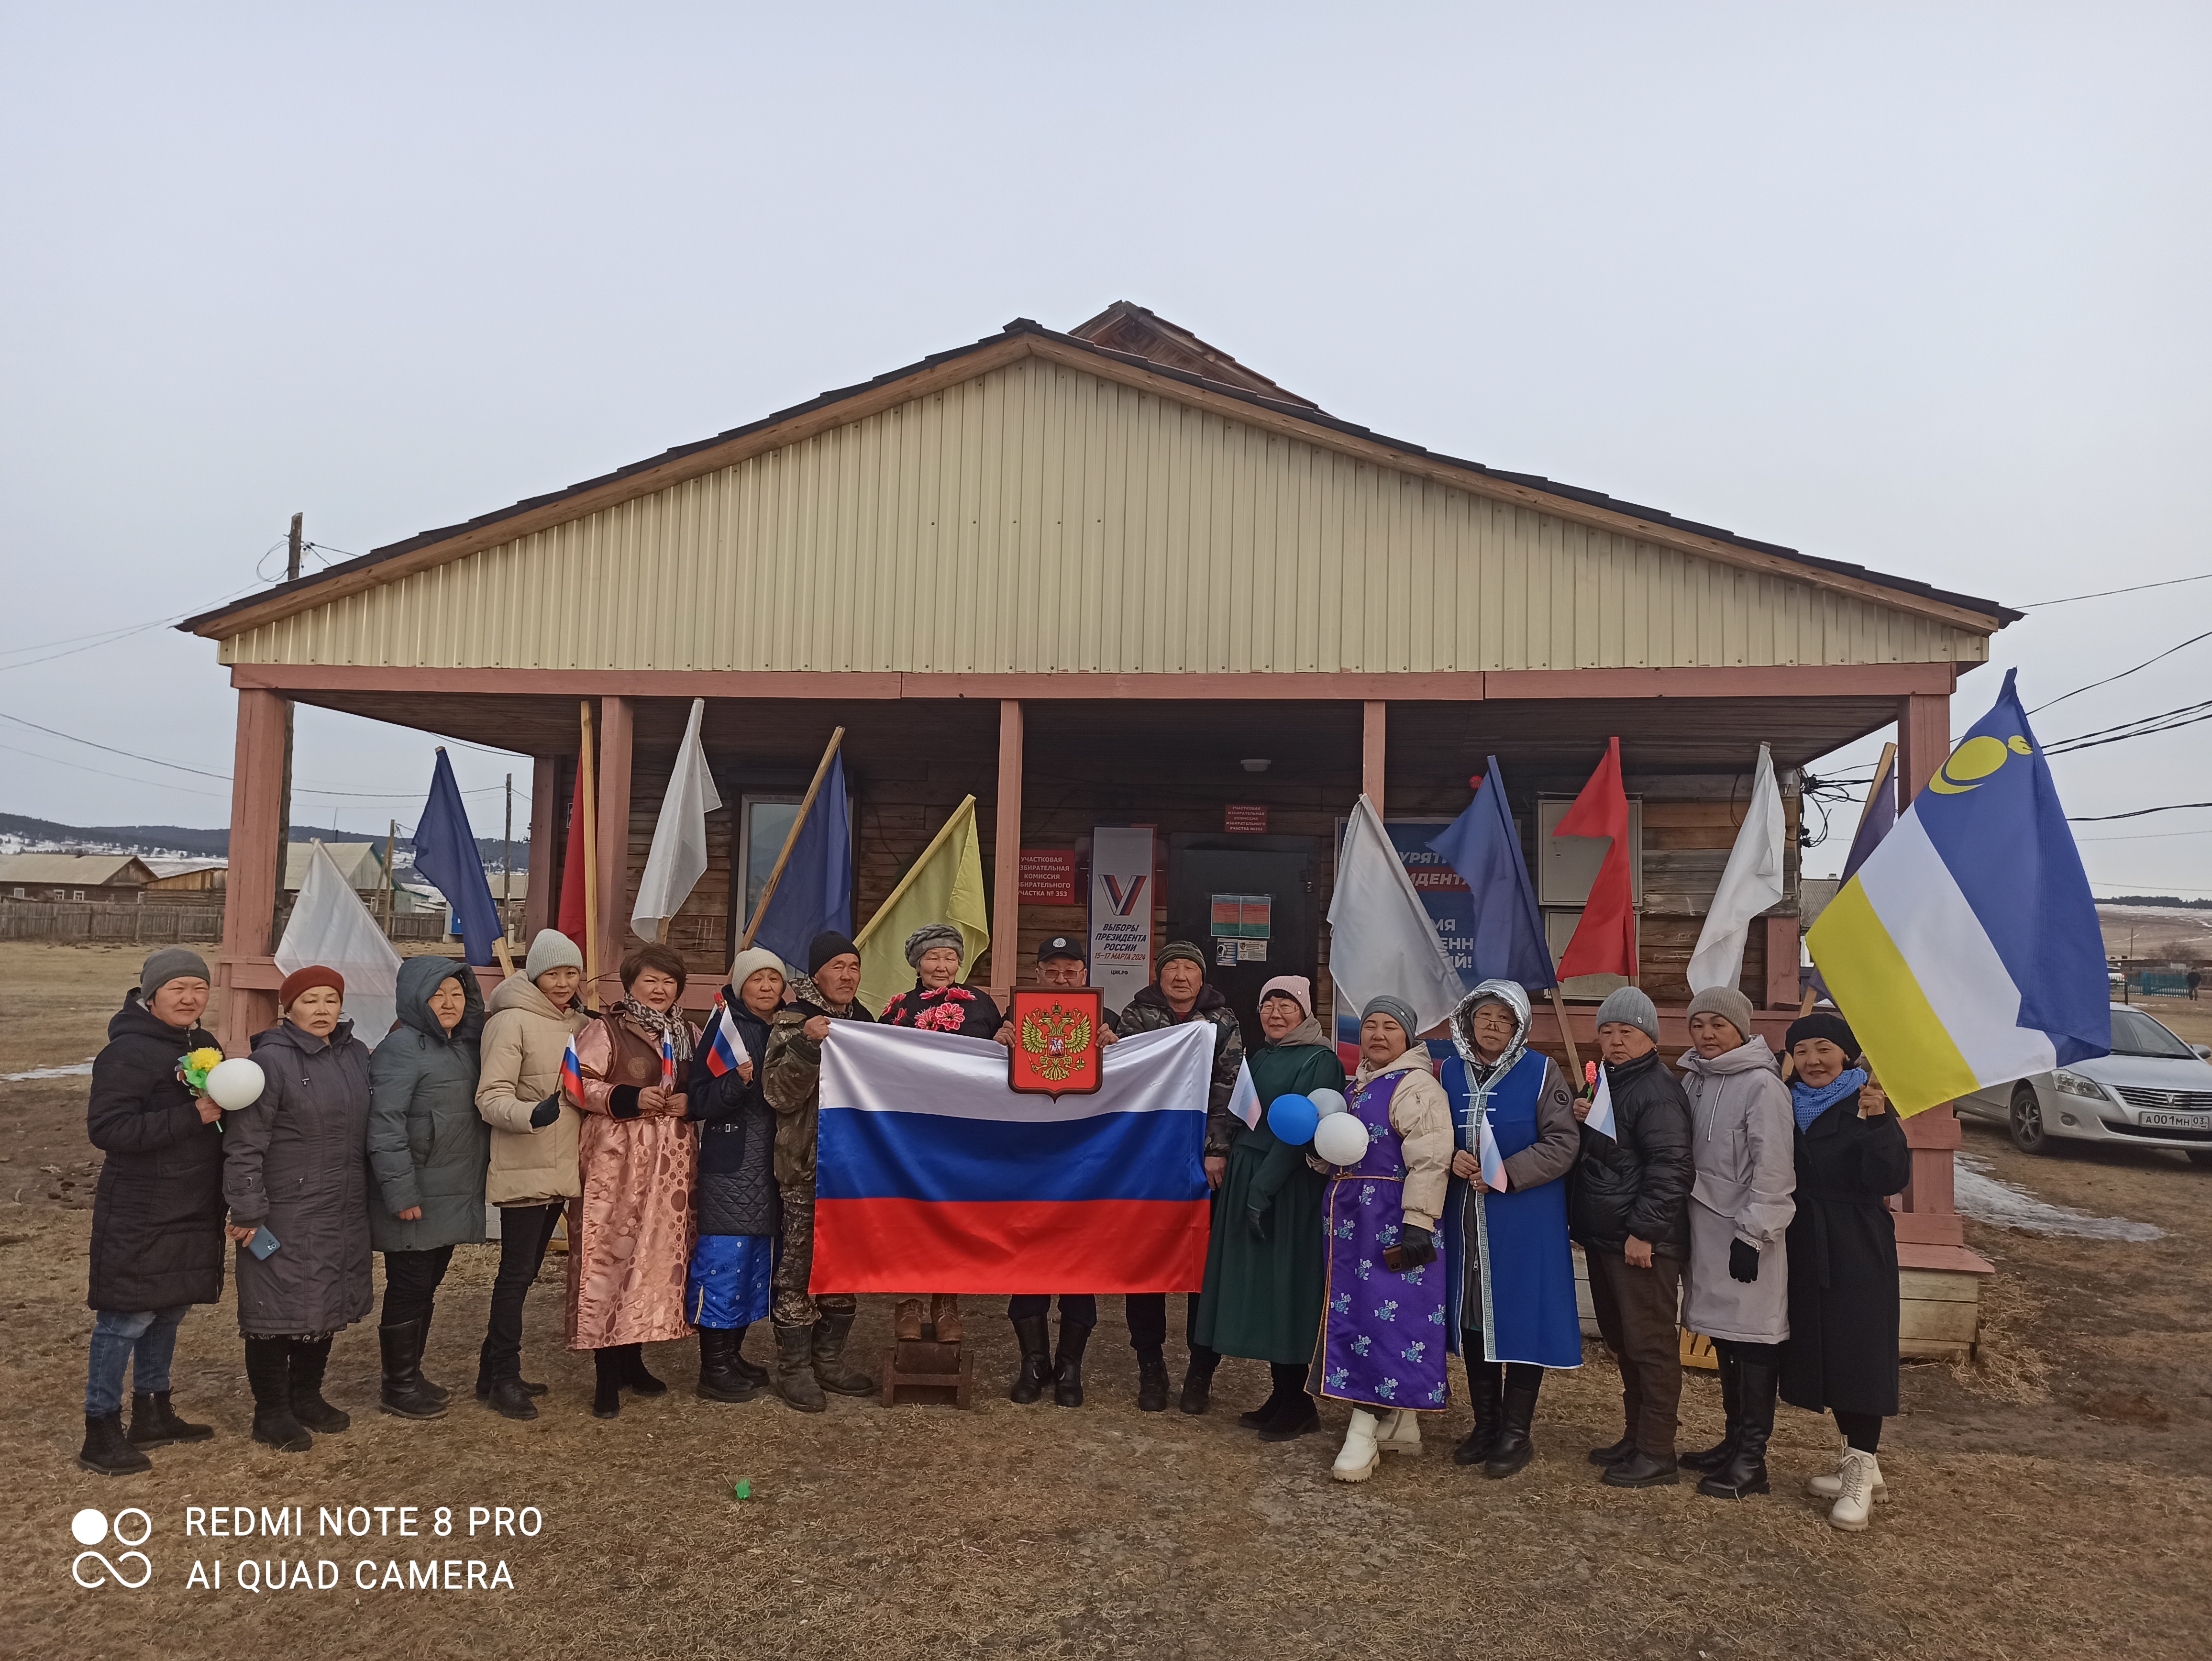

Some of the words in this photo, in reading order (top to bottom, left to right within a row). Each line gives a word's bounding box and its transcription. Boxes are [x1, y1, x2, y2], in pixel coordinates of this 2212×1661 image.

[1398, 852, 1447, 864] УРЯТ
[1408, 873, 1468, 886] ИДЕНТ
[1102, 923, 1139, 932] ВЫБОРЫ
[1430, 919, 1455, 931] МЯ
[1095, 933, 1147, 942] ПРЕЗИДЕНТА
[1440, 937, 1473, 950] ЕНН
[1103, 943, 1138, 952] РОССИИ
